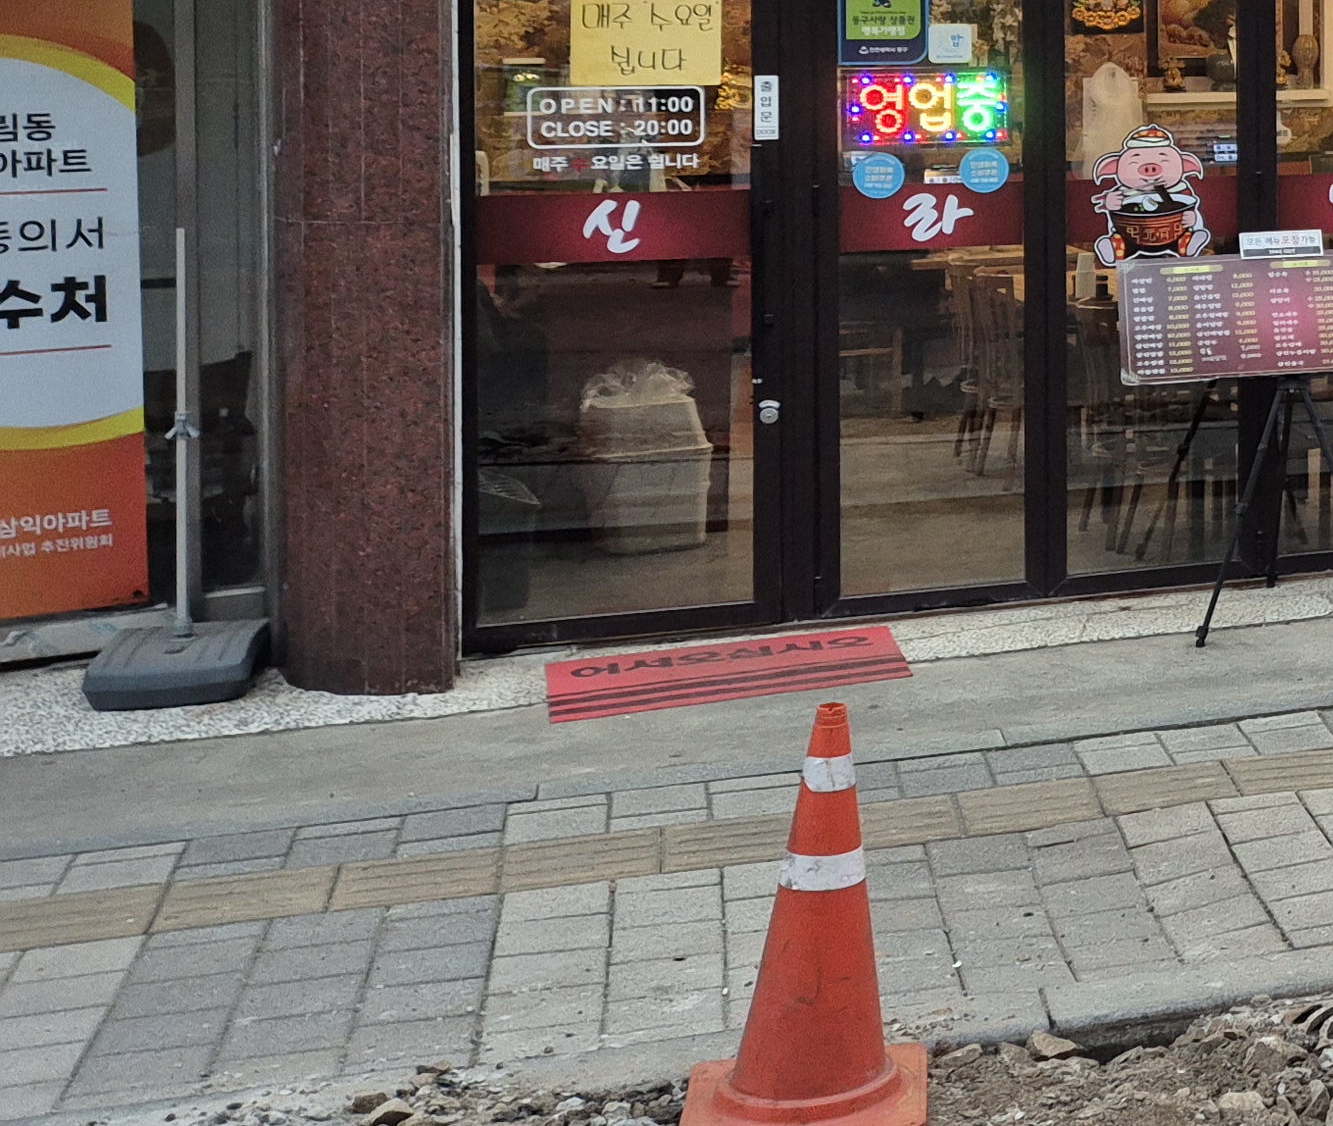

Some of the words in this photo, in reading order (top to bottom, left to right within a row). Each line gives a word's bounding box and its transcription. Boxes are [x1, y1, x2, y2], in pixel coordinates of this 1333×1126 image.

[581, 1, 633, 29] 매주
[539, 97, 614, 115] OPEN
[760, 80, 772, 123] 출입문
[859, 81, 997, 133] 영업중
[540, 120, 614, 139] CLOSE
[633, 118, 694, 137] 20:00
[532, 156, 569, 173] 매주
[582, 199, 642, 253] 신
[903, 193, 974, 242] 라
[0, 275, 107, 329] 수처
[0, 508, 113, 539] 삼익아파트
